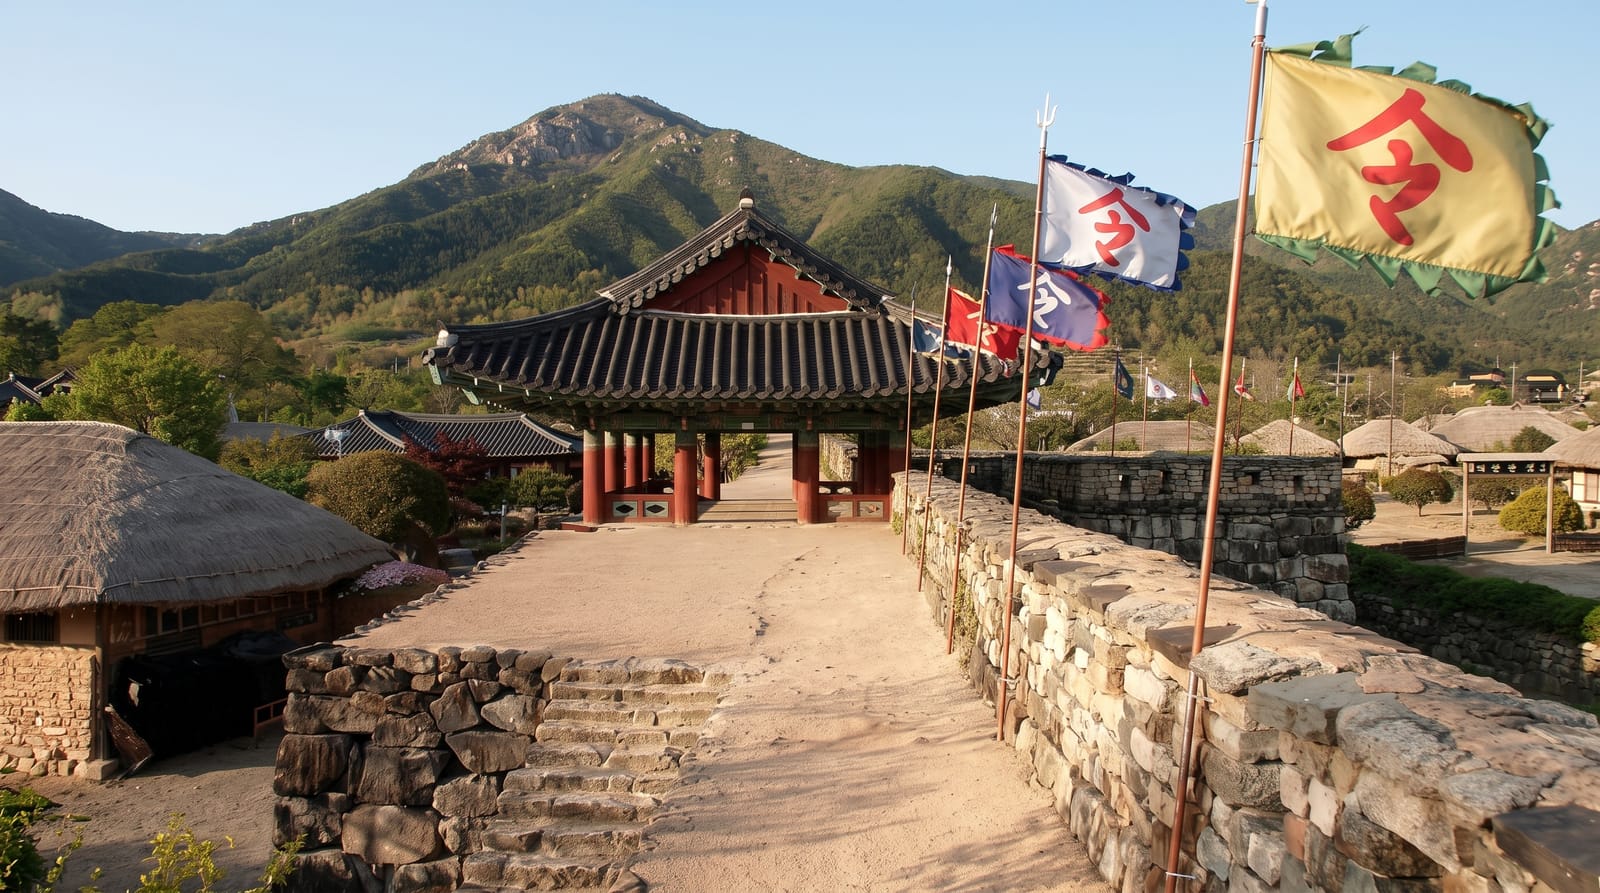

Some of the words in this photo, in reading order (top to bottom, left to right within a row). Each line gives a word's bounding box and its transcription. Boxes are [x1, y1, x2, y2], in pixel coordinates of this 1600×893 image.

[1326, 87, 1474, 247] 令
[1078, 188, 1150, 267] 令
[1017, 271, 1072, 329] 令
